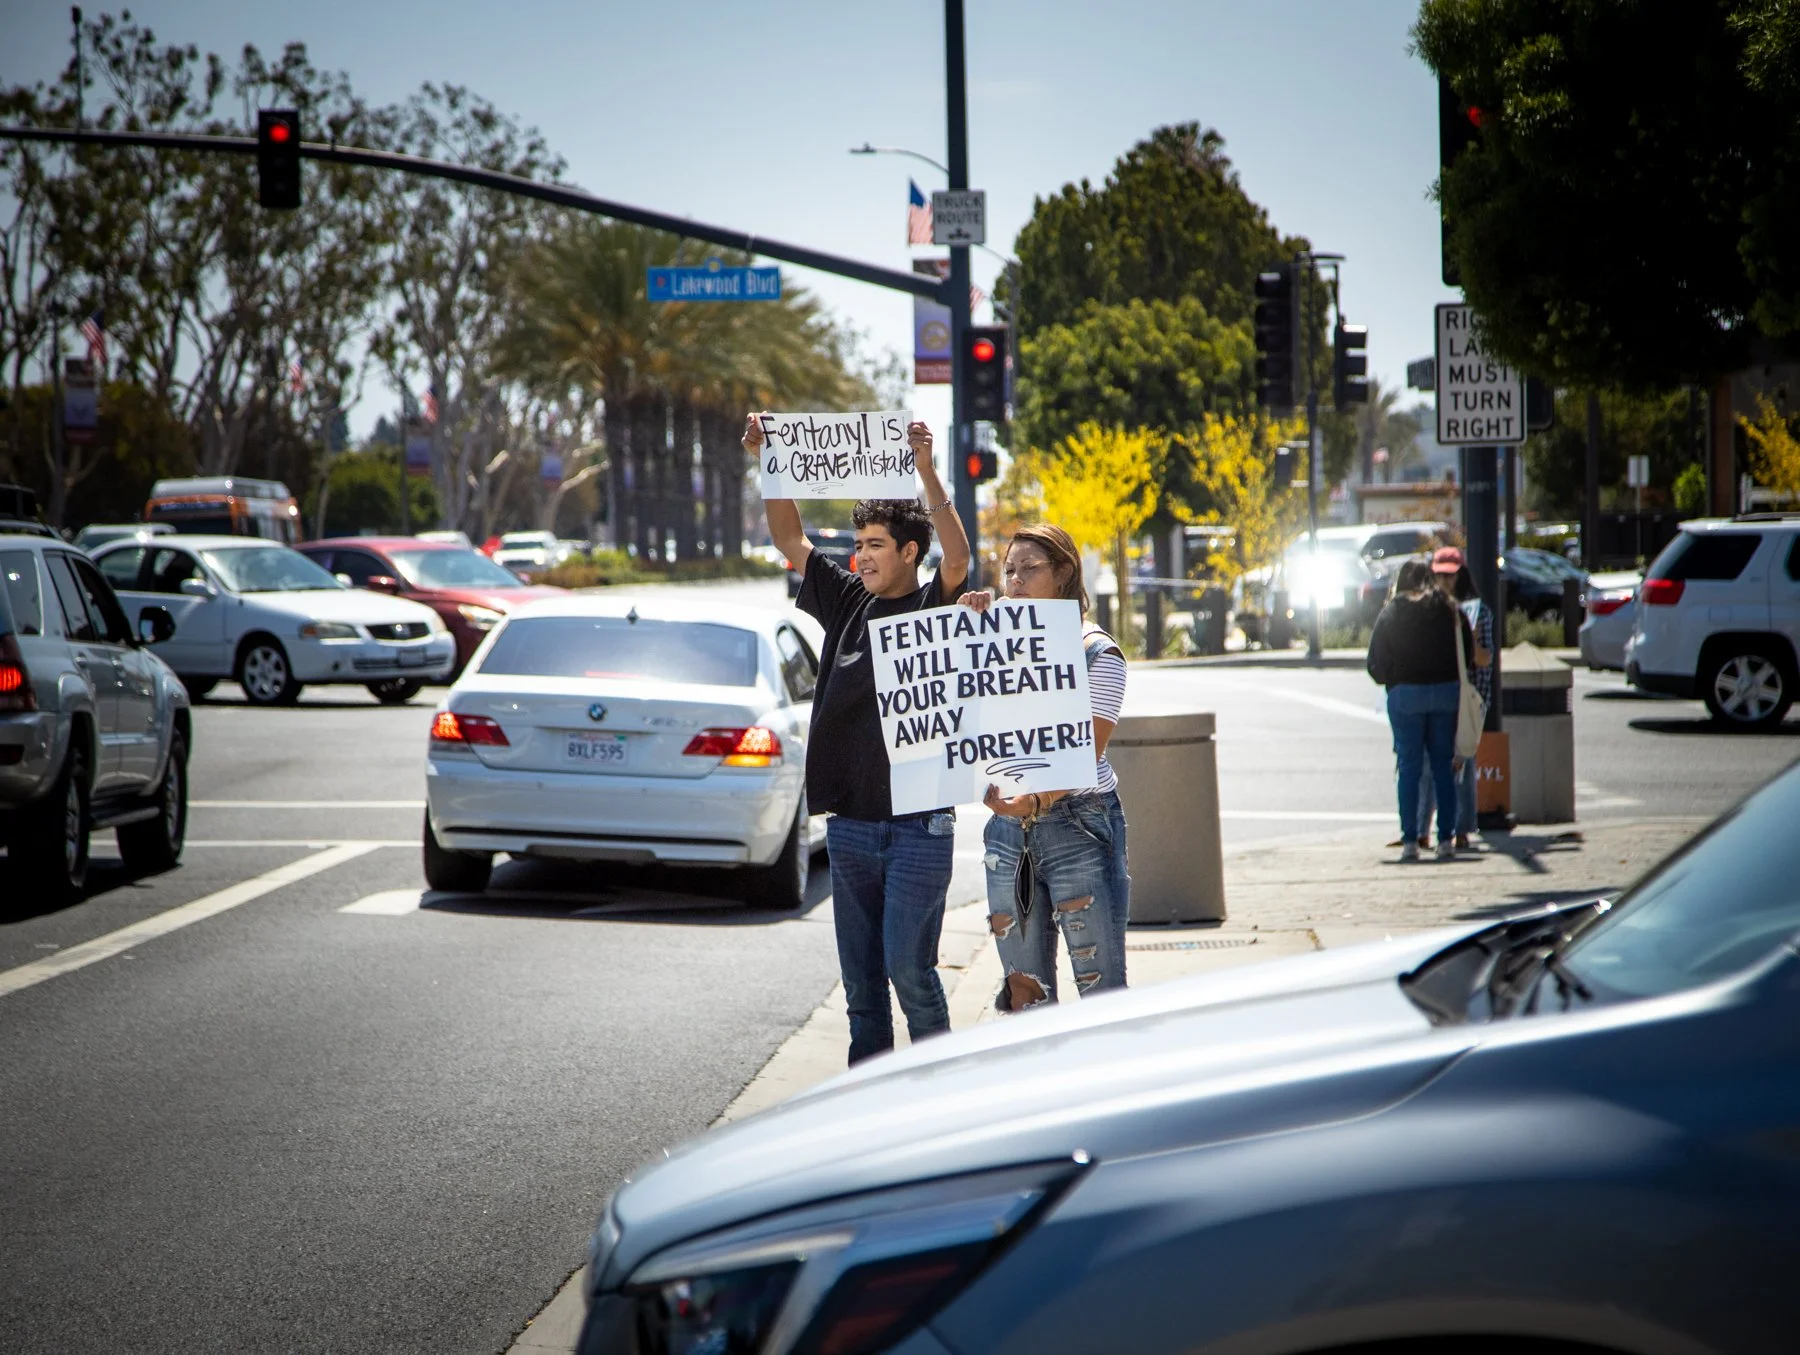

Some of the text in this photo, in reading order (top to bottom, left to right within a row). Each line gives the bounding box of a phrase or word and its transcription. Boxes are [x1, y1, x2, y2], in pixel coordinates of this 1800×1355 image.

[936, 196, 982, 208] TRUCK
[937, 211, 980, 225] ROUTE
[672, 270, 777, 296] Lakewood Blvd
[1446, 311, 1483, 330] RIG
[1451, 390, 1512, 411] TURN
[760, 413, 903, 455] Fentanyl is
[1447, 417, 1514, 438] RIGHT
[767, 448, 915, 482] a GRAVE mistake
[879, 605, 1045, 653] FENTANYL
[894, 637, 1046, 684] WILL TAKE
[878, 664, 1076, 718] YOUR BREATH
[895, 707, 963, 748] AWAY
[946, 721, 1092, 769] FOREVER!!
